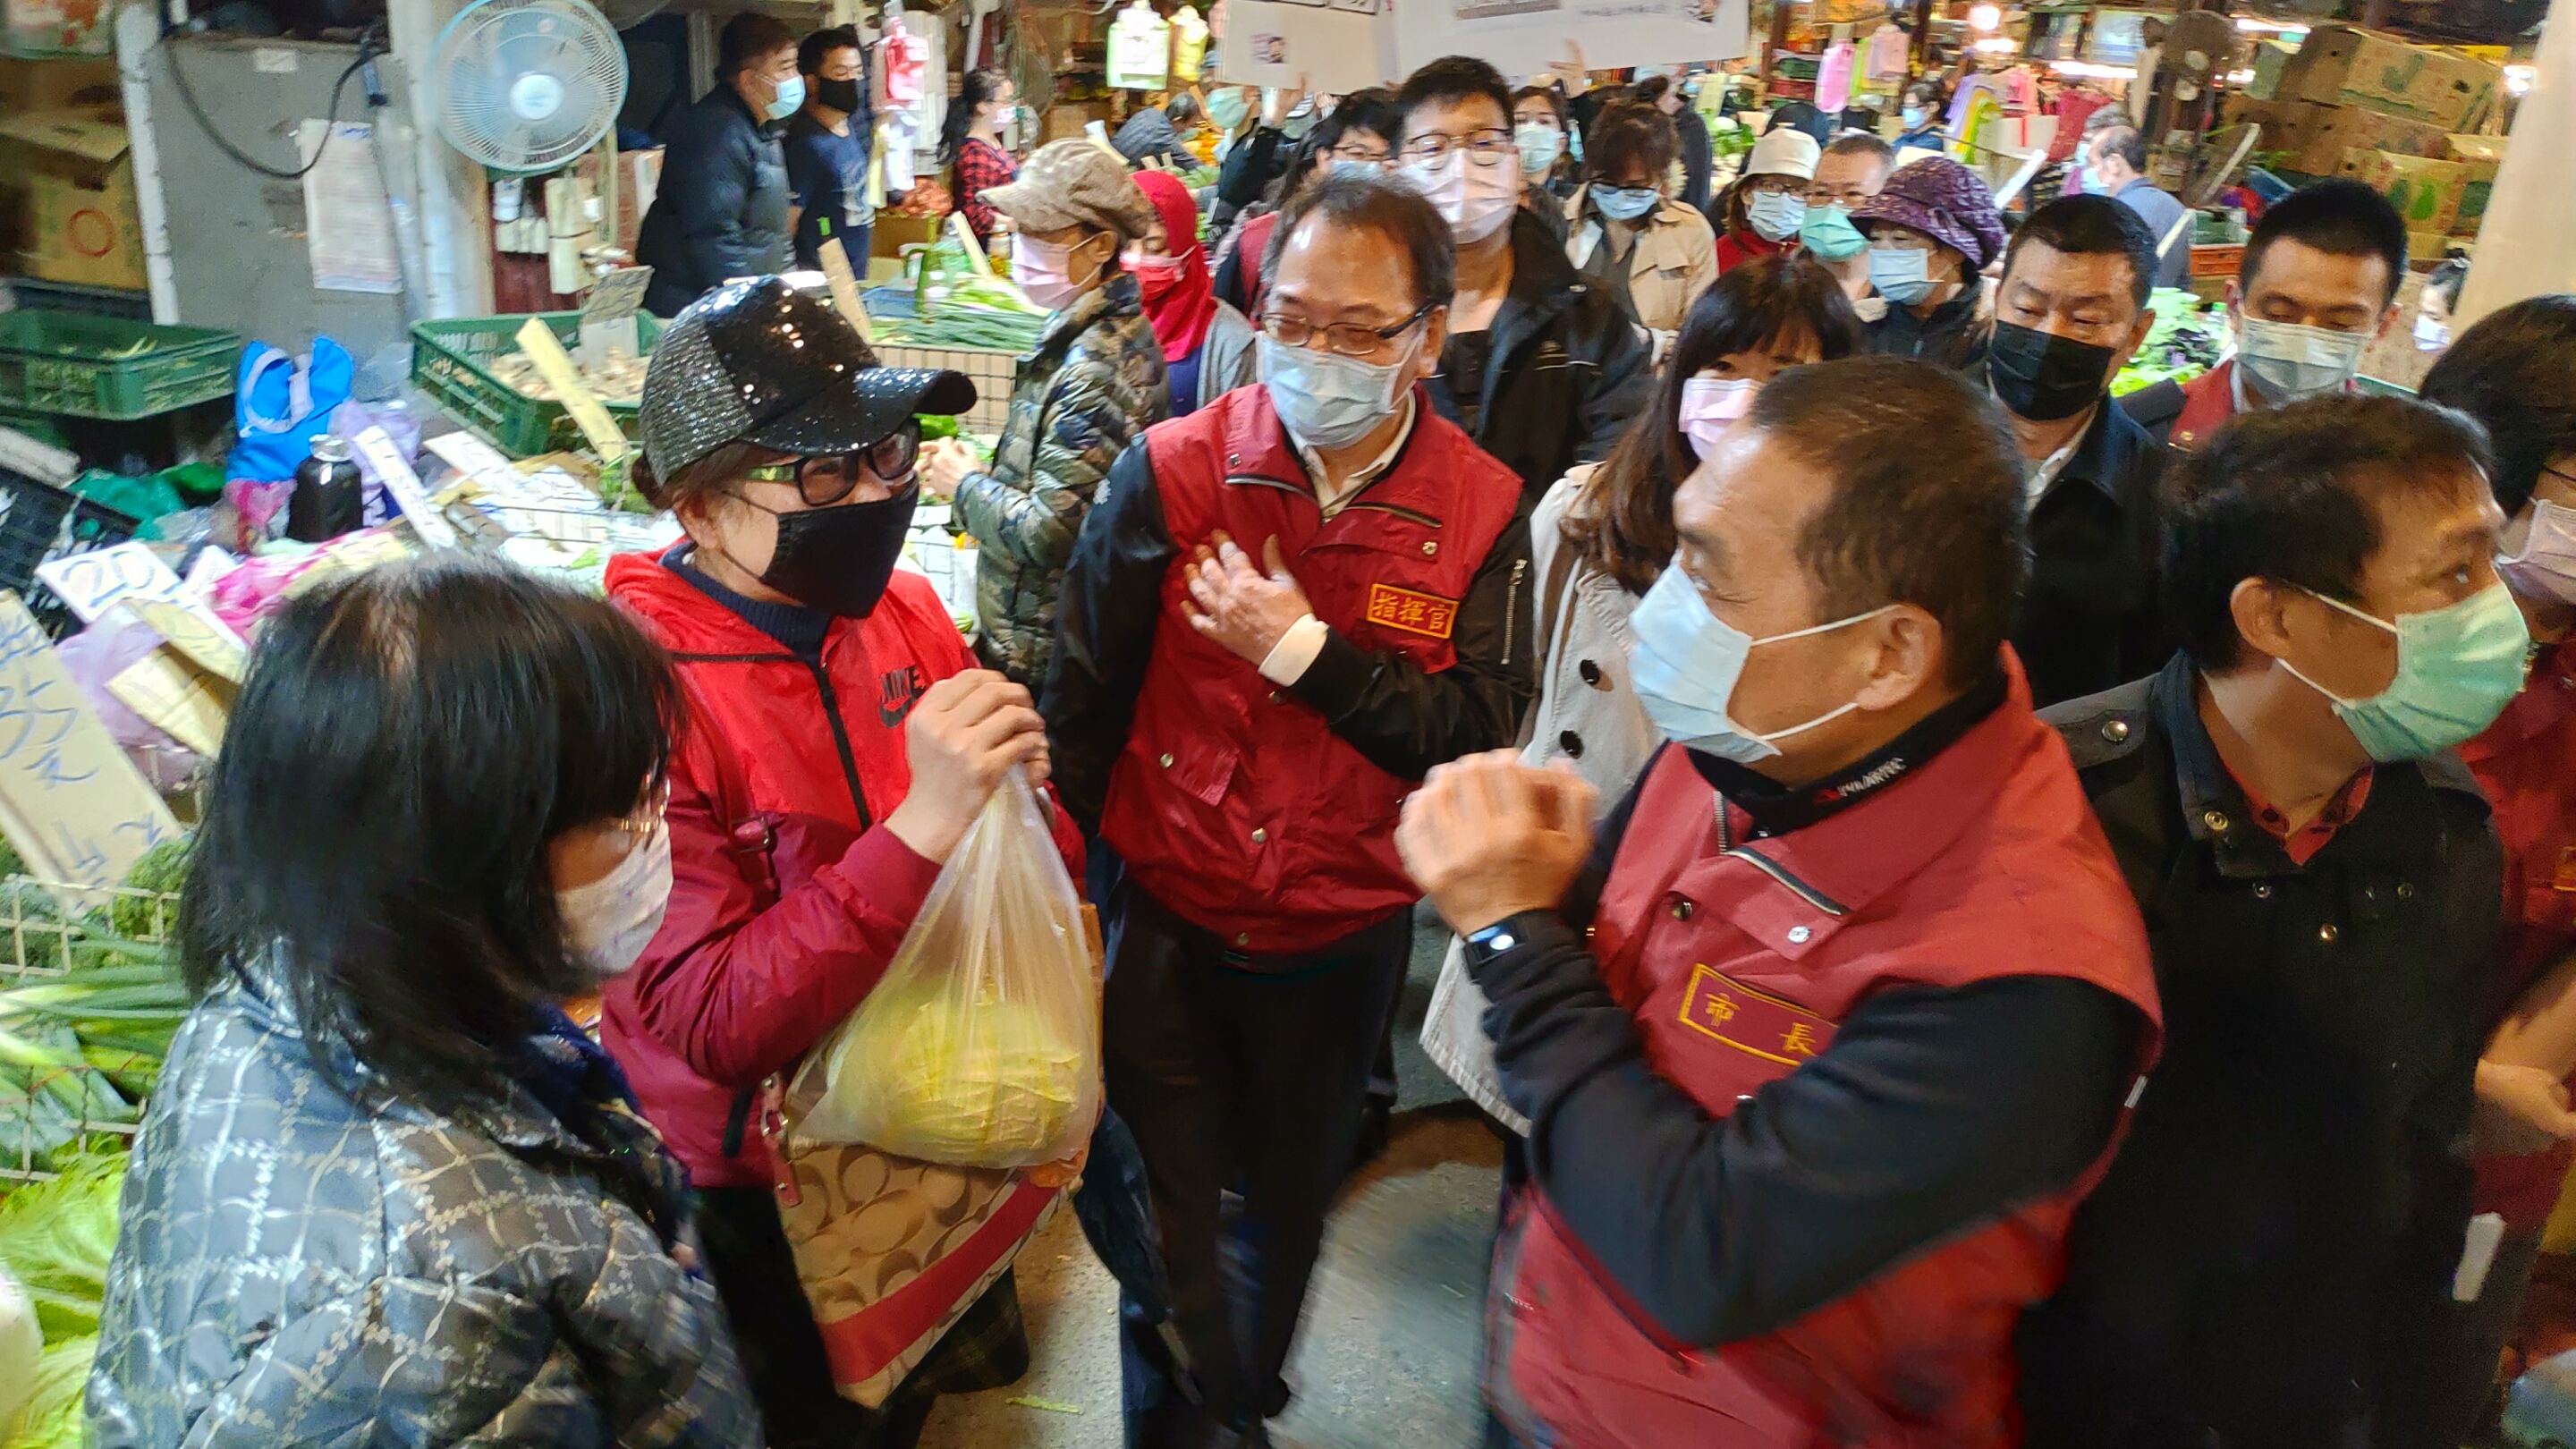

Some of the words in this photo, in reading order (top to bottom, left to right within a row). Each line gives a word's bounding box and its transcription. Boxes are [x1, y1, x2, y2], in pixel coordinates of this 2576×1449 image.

[1372, 591, 1451, 631] 指揮官
[880, 665, 926, 702] NIKE
[1706, 992, 1818, 1058] 市長
